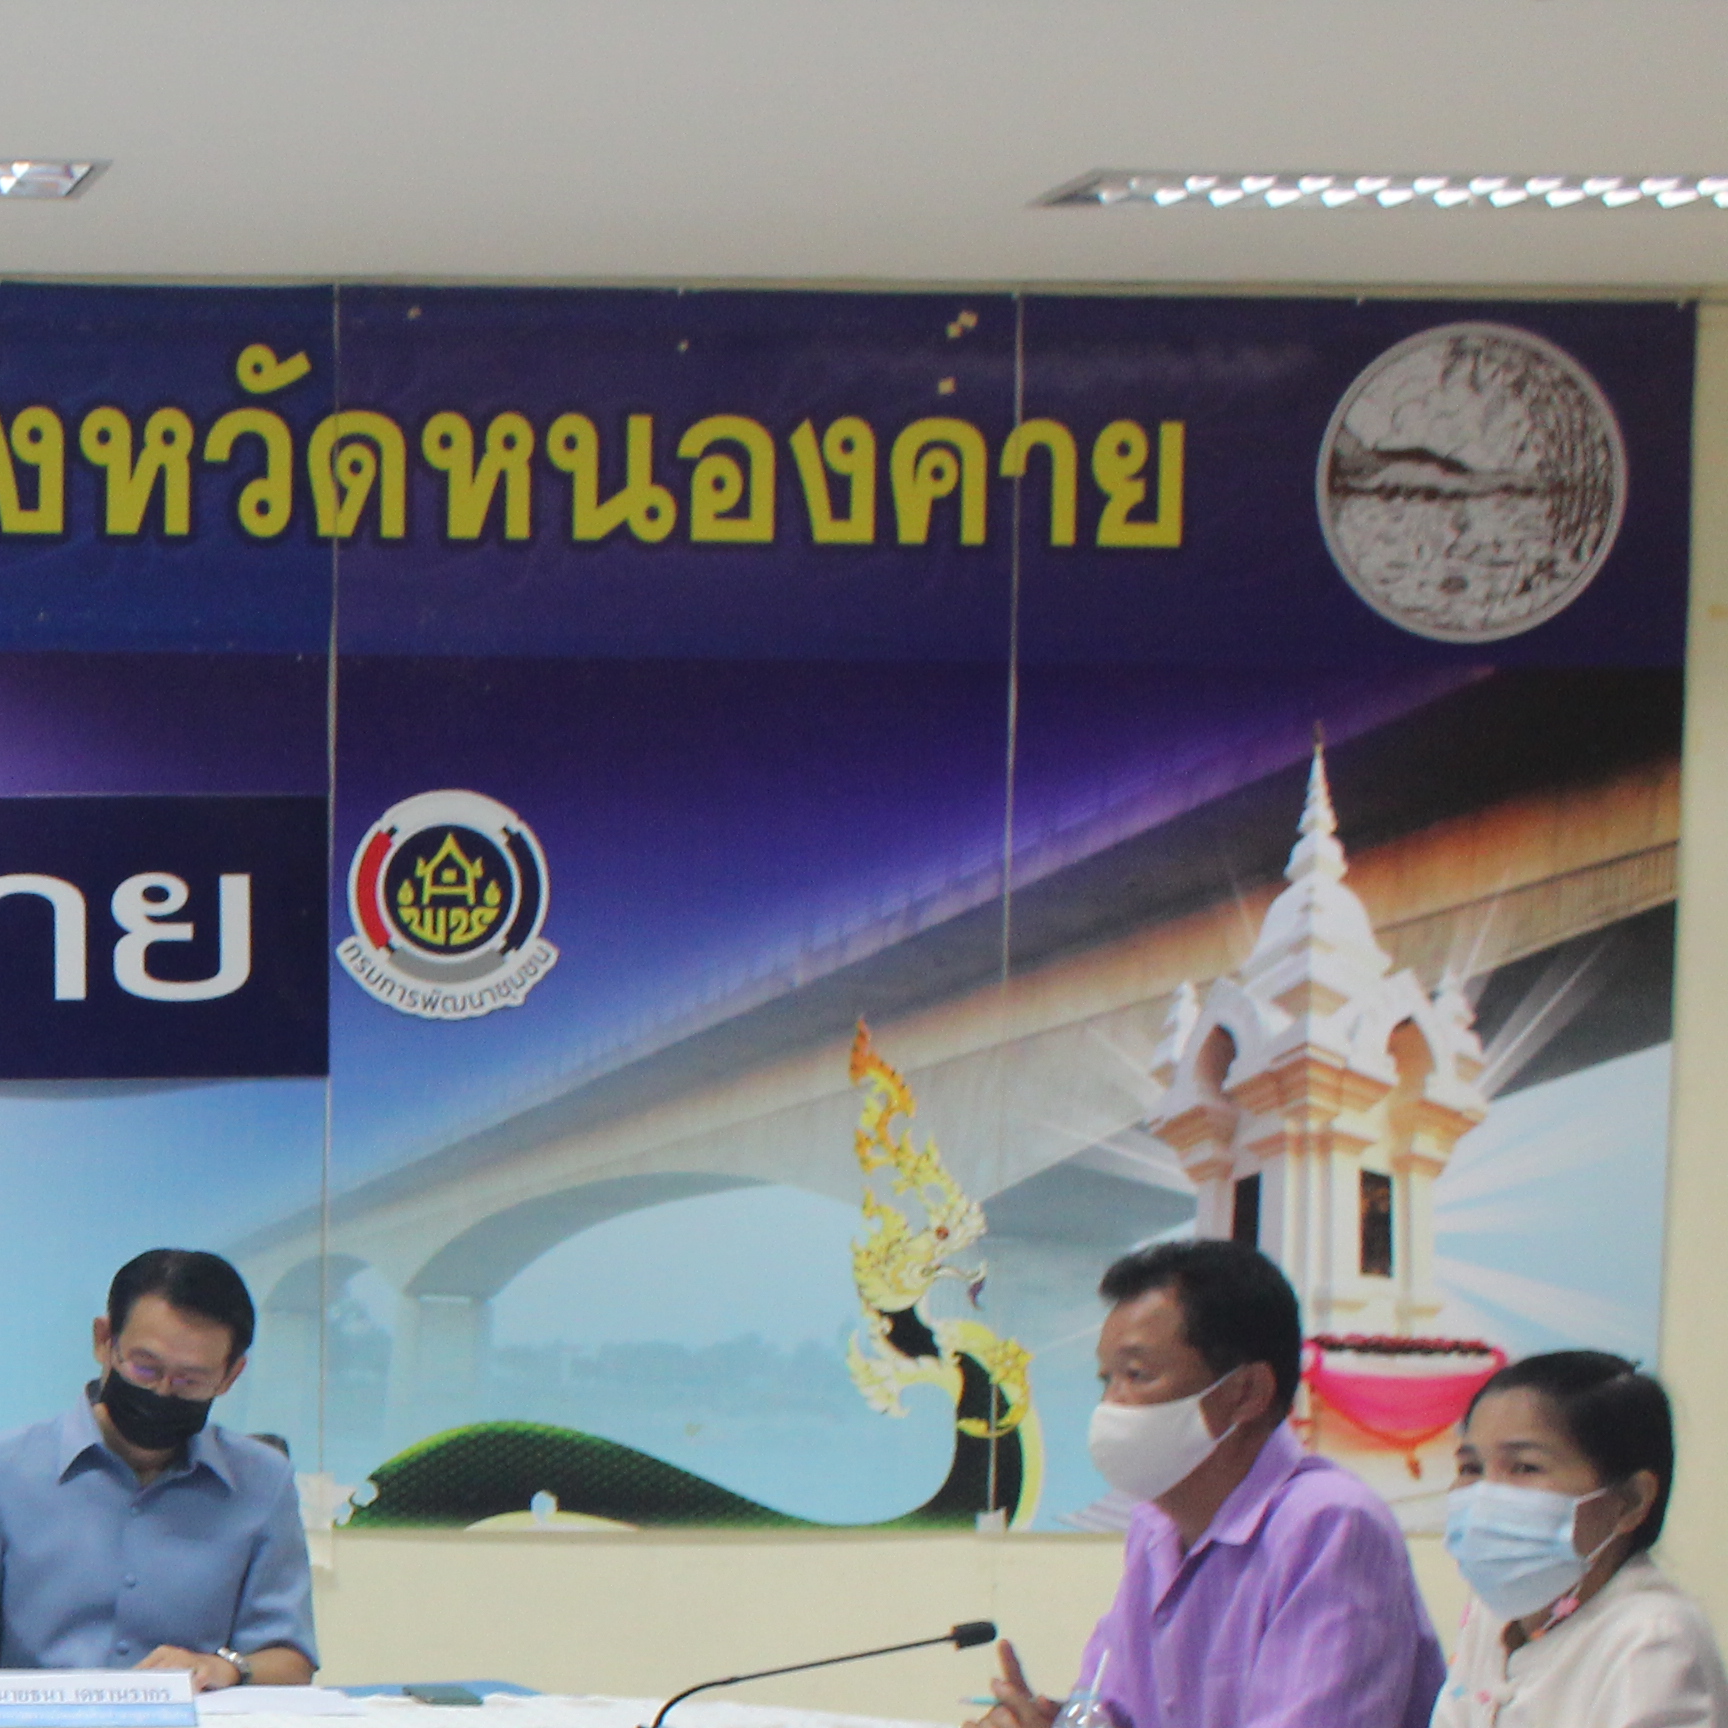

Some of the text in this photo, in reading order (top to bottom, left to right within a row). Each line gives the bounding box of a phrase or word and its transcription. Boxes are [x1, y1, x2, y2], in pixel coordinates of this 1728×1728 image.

[342, 942, 551, 1014] กรมการพัฒนาชุมชน
